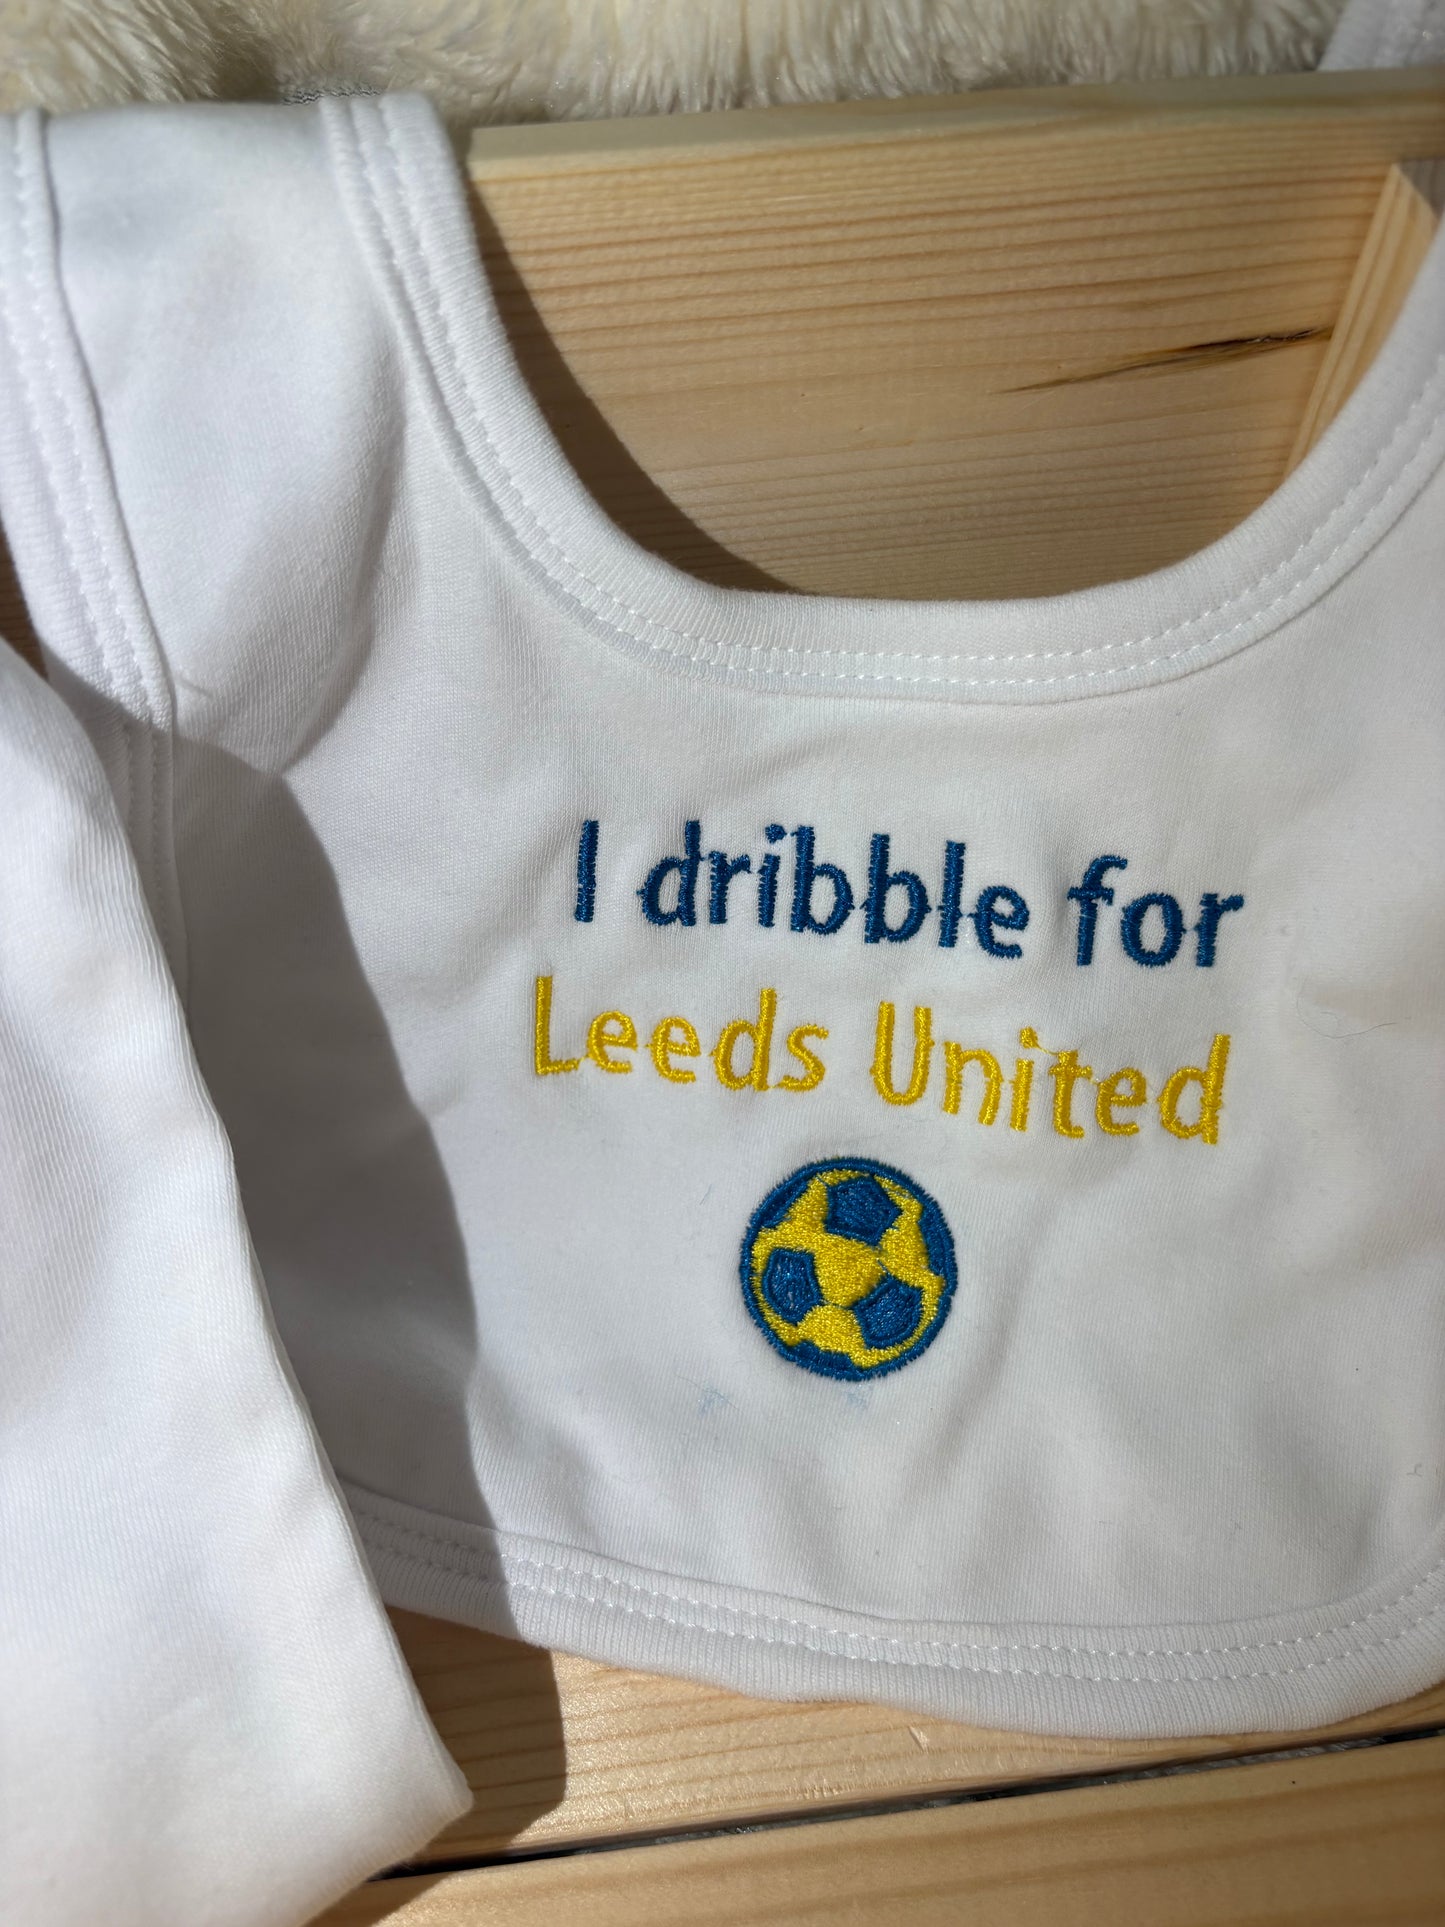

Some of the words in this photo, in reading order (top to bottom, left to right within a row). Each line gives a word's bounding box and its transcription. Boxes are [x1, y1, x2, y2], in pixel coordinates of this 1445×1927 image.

[574, 819, 599, 923] I
[637, 820, 1030, 959] dribble
[1066, 855, 1245, 968] for
[534, 975, 830, 1093] Leeds
[868, 1001, 1231, 1146] United
